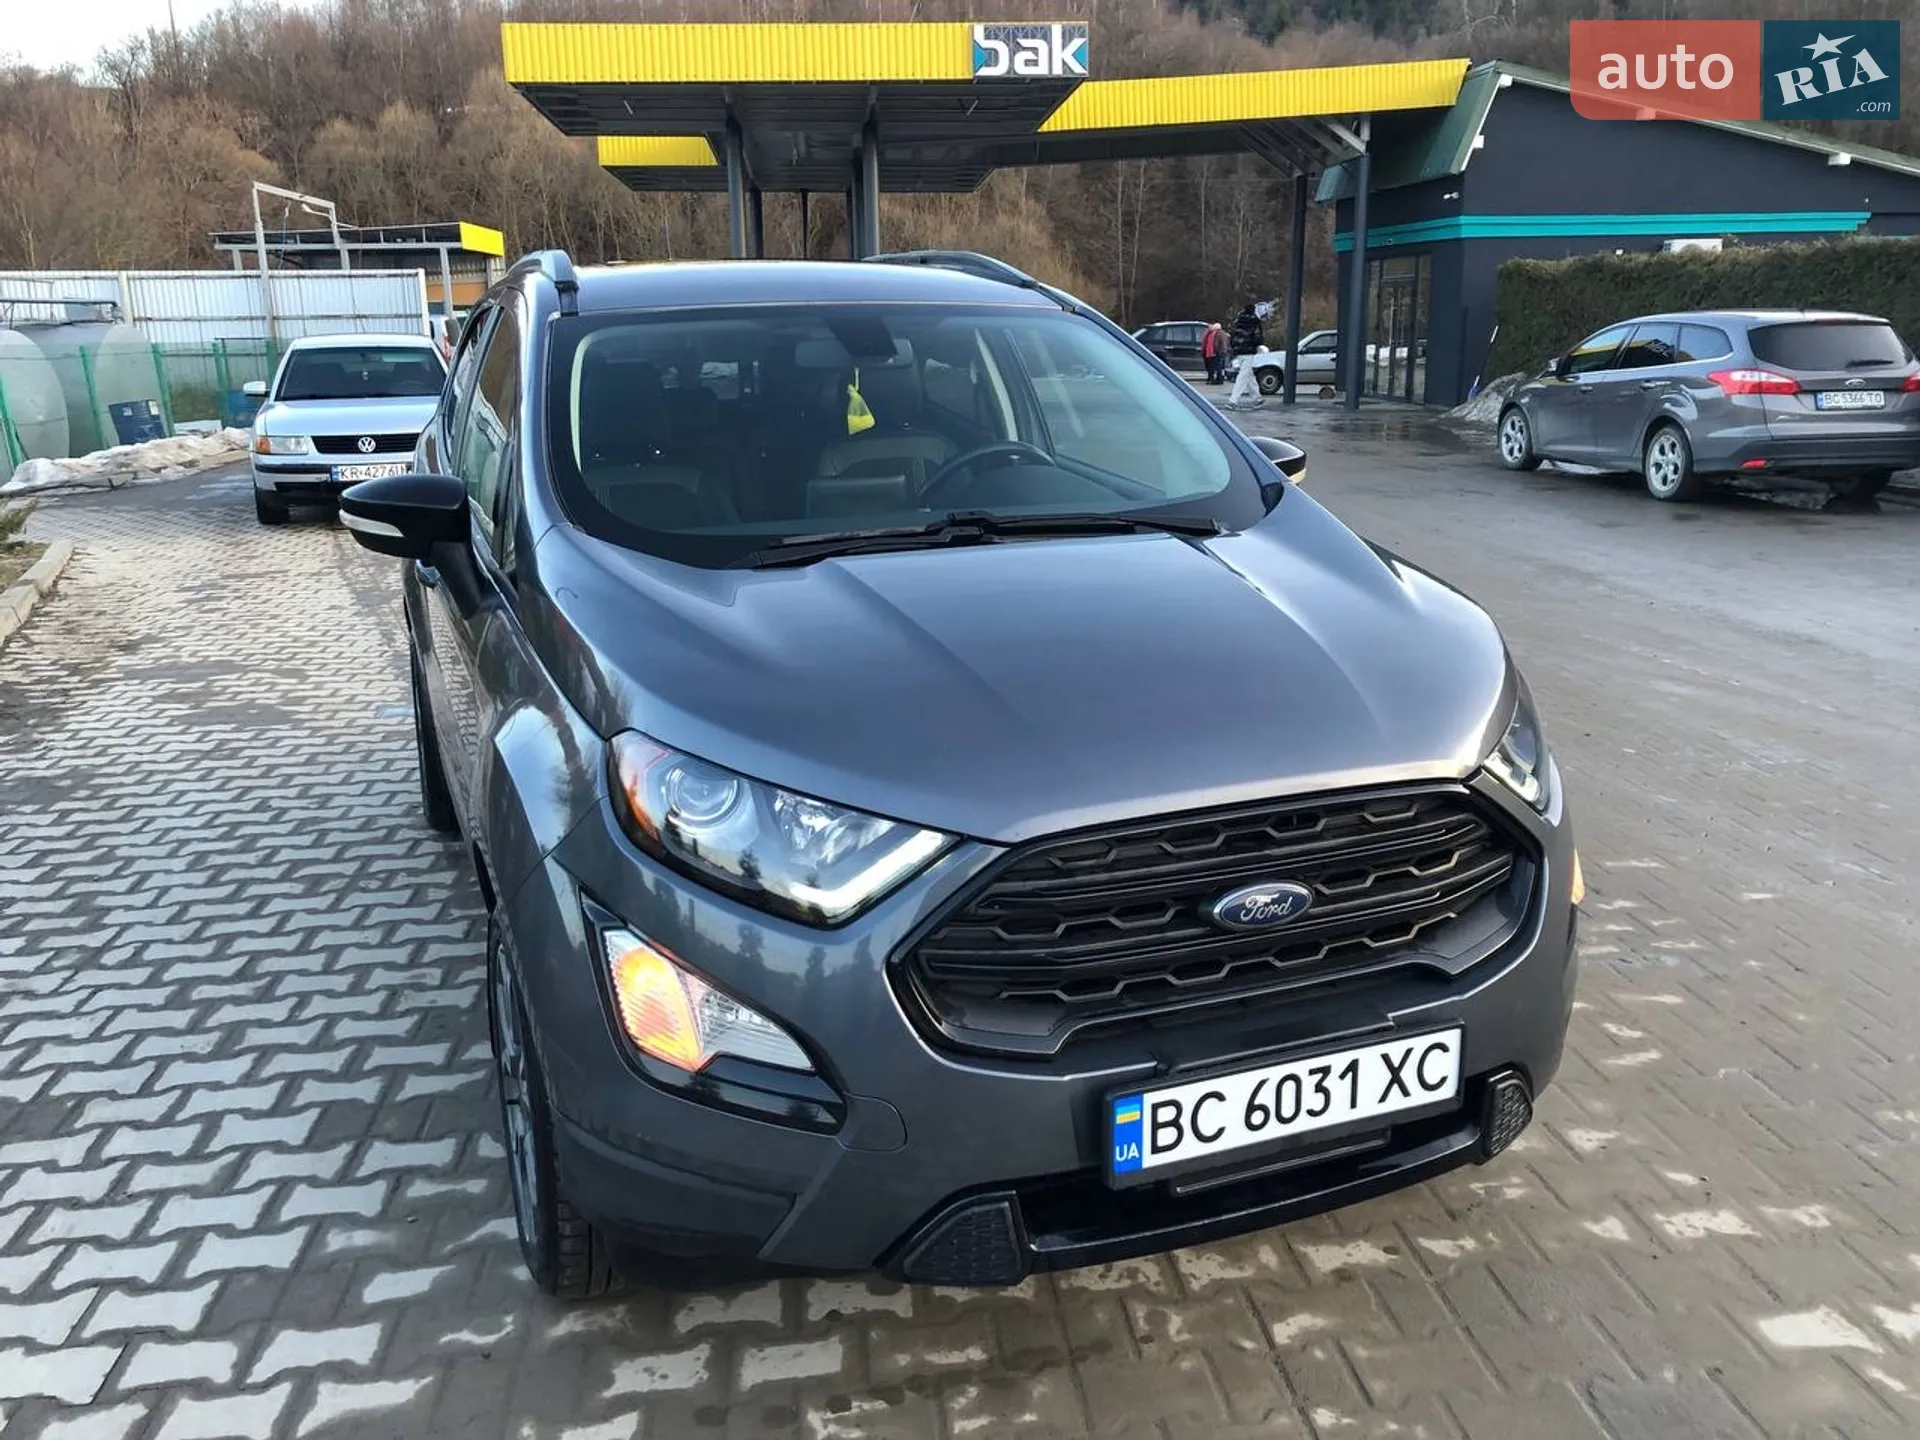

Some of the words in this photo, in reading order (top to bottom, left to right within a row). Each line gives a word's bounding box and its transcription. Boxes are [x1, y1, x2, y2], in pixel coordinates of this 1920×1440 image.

[1240, 893, 1293, 921] Ford
[1150, 1091, 1227, 1155] BC
[1243, 1058, 1361, 1132] 6031
[1378, 1042, 1450, 1104] XC
[1115, 1143, 1140, 1162] UA
